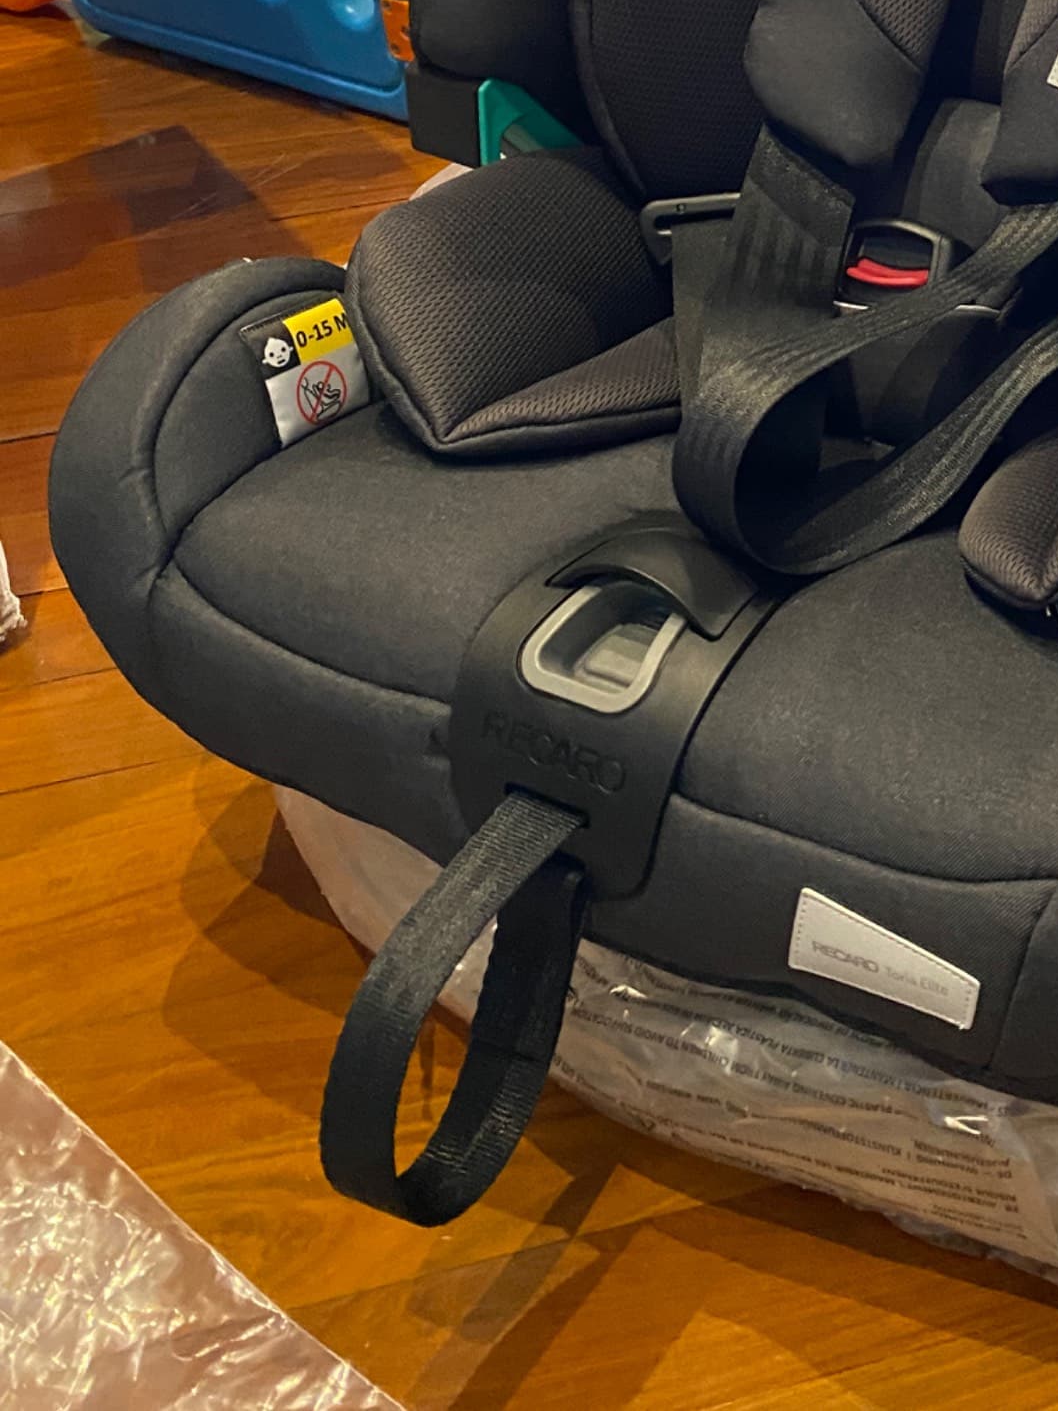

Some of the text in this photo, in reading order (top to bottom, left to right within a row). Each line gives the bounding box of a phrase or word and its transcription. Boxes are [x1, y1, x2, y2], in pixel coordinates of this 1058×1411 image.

[295, 319, 333, 348] 0-15
[481, 710, 627, 795] RECARO
[811, 939, 880, 975] RECARO
